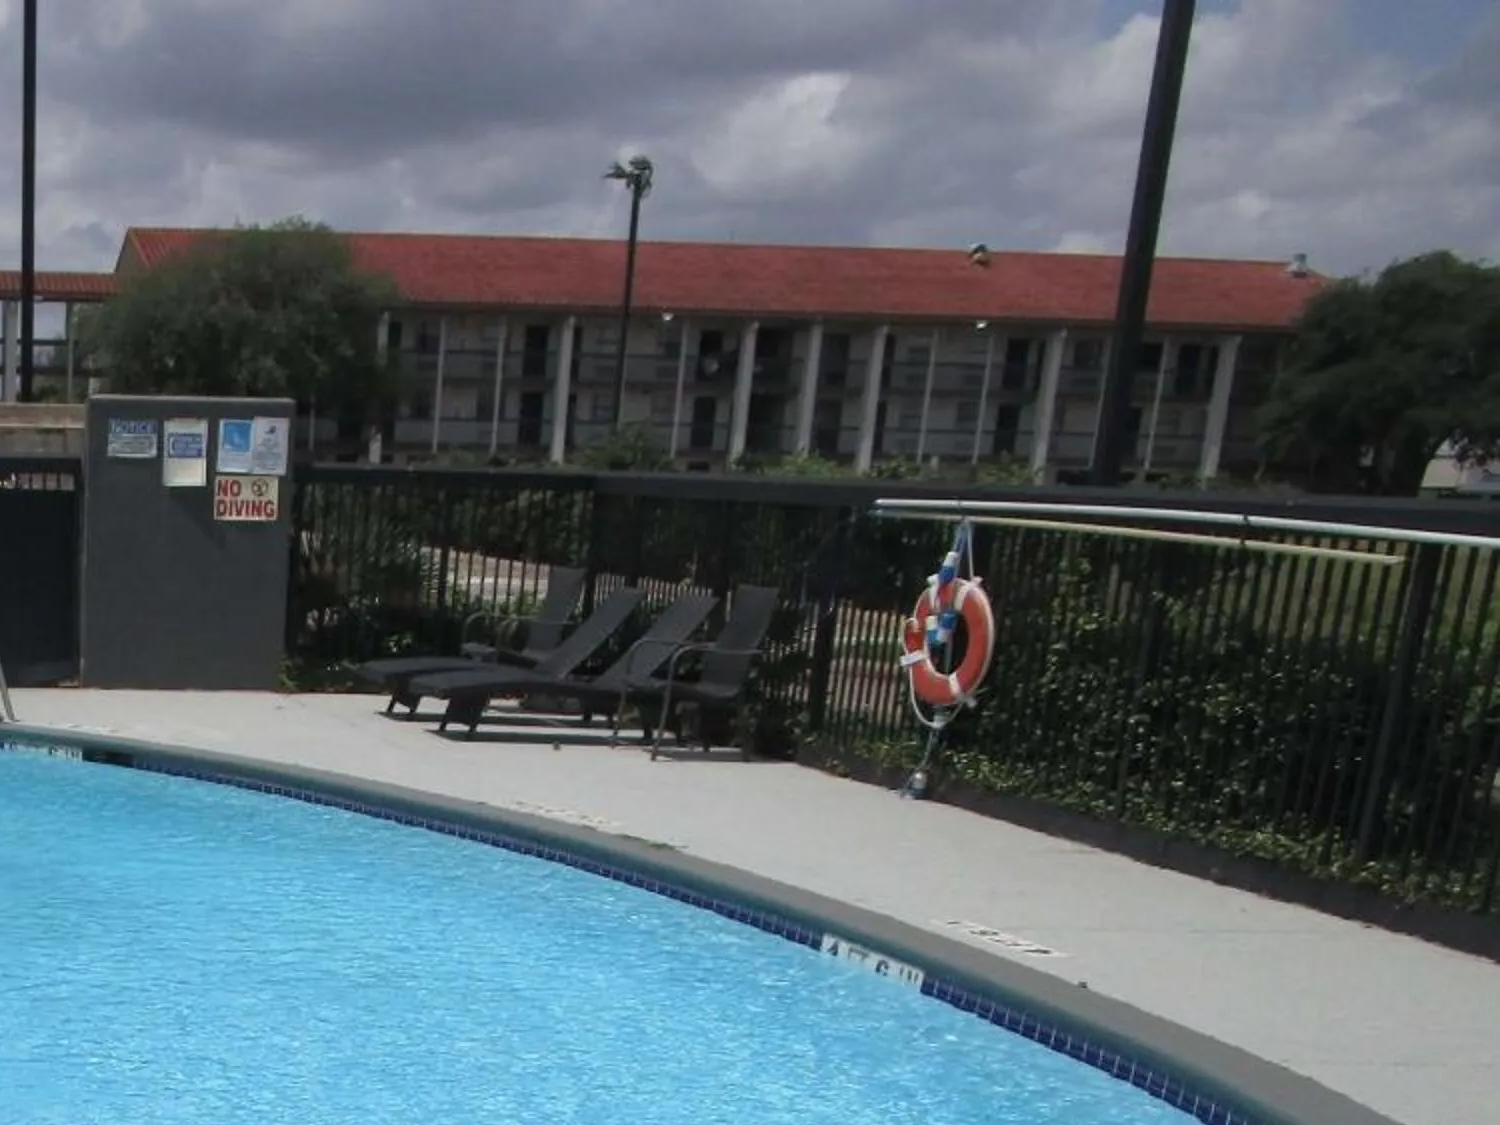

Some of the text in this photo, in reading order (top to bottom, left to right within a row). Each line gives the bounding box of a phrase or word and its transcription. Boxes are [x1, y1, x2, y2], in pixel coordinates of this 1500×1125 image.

[111, 422, 155, 434] NOTICE
[217, 479, 241, 497] NO
[216, 500, 276, 518] DIVING
